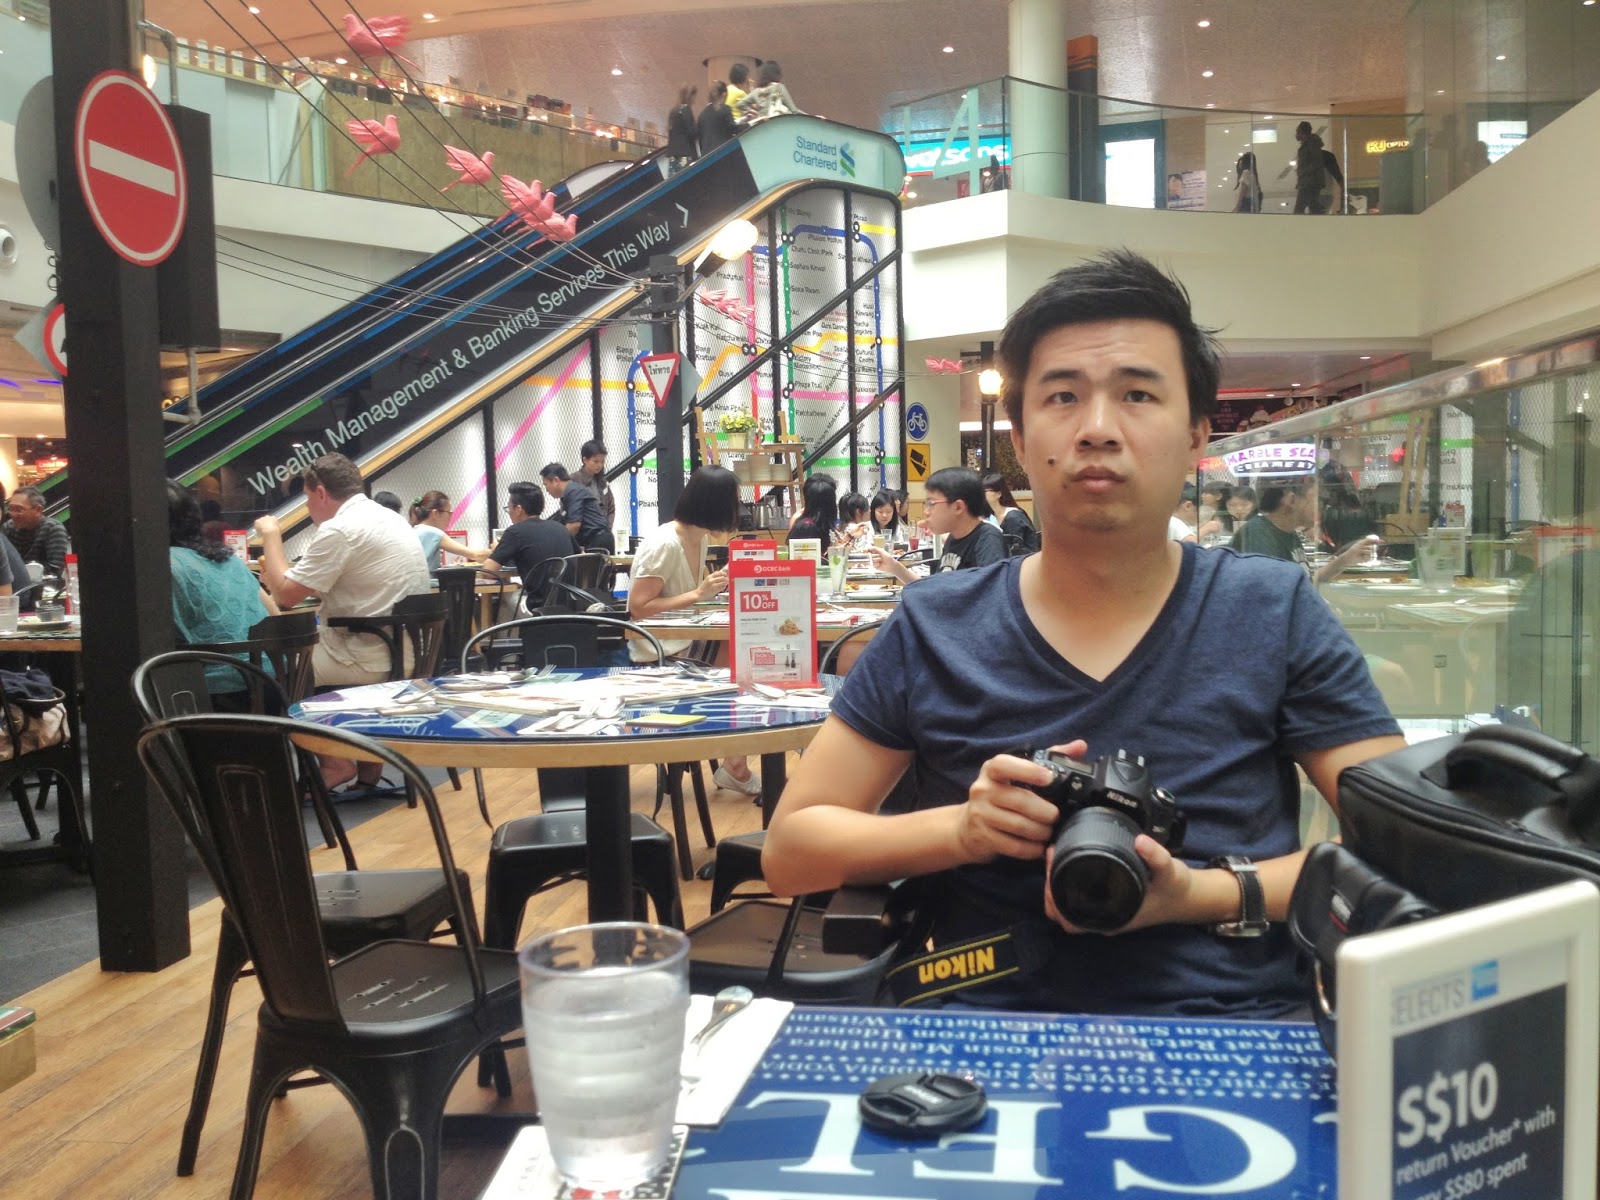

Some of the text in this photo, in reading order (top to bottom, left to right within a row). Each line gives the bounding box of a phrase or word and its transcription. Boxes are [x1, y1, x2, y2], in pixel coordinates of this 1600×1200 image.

[796, 135, 837, 156] Standard
[793, 150, 838, 171] Chartered
[247, 221, 671, 496] Wealth Management & Banking Services This Way
[1227, 446, 1316, 466] MARBLE SLA
[762, 601, 776, 609] OFF
[1106, 790, 1138, 809] Nikon
[917, 945, 996, 985] Nikon
[1393, 977, 1466, 1028] ELECTS
[784, 1025, 1322, 1054] Udomrat Burirom Ratchathani pharat
[1083, 1022, 1171, 1037] Sathit
[1175, 1026, 1281, 1040] Awatan
[789, 1038, 1337, 1068] Mahinthara Rattanakosin Amon khon
[1027, 1070, 1057, 1082] BY
[1064, 1072, 1146, 1085] GIVEN
[1152, 1075, 1214, 1087] CITY
[1217, 1077, 1272, 1089] THE
[1277, 1079, 1312, 1091] OF
[1396, 1061, 1499, 1150] S$10
[744, 1090, 1298, 1195] GEL
[1396, 1152, 1449, 1186] return
[1524, 1104, 1557, 1133] with
[1444, 1151, 1529, 1200] S$80 spent
